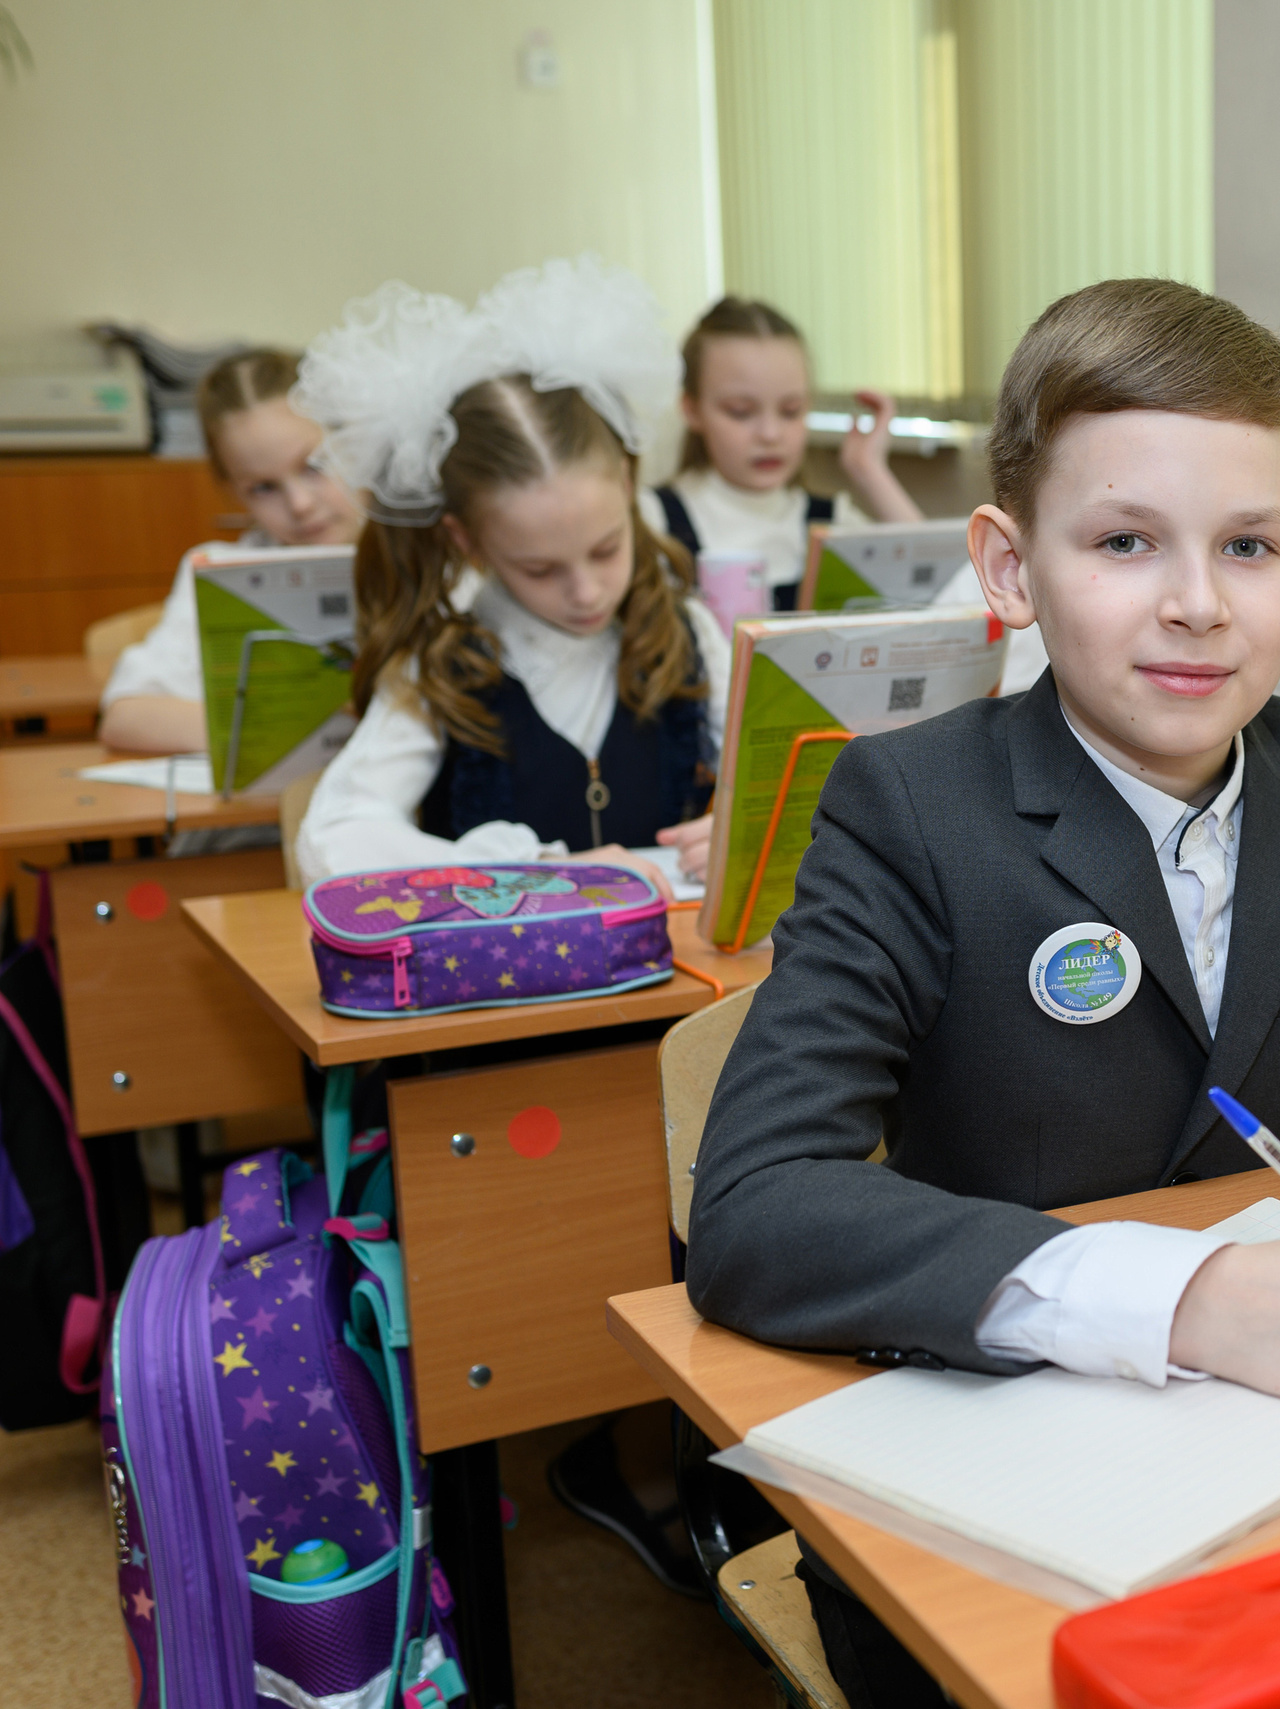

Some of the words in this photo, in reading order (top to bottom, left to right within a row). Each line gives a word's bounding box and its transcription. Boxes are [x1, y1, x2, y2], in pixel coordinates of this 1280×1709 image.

[1058, 954, 1110, 970] ЛИДЕР
[1058, 972, 1091, 980] начальной
[1064, 998, 1089, 1009] Школа
